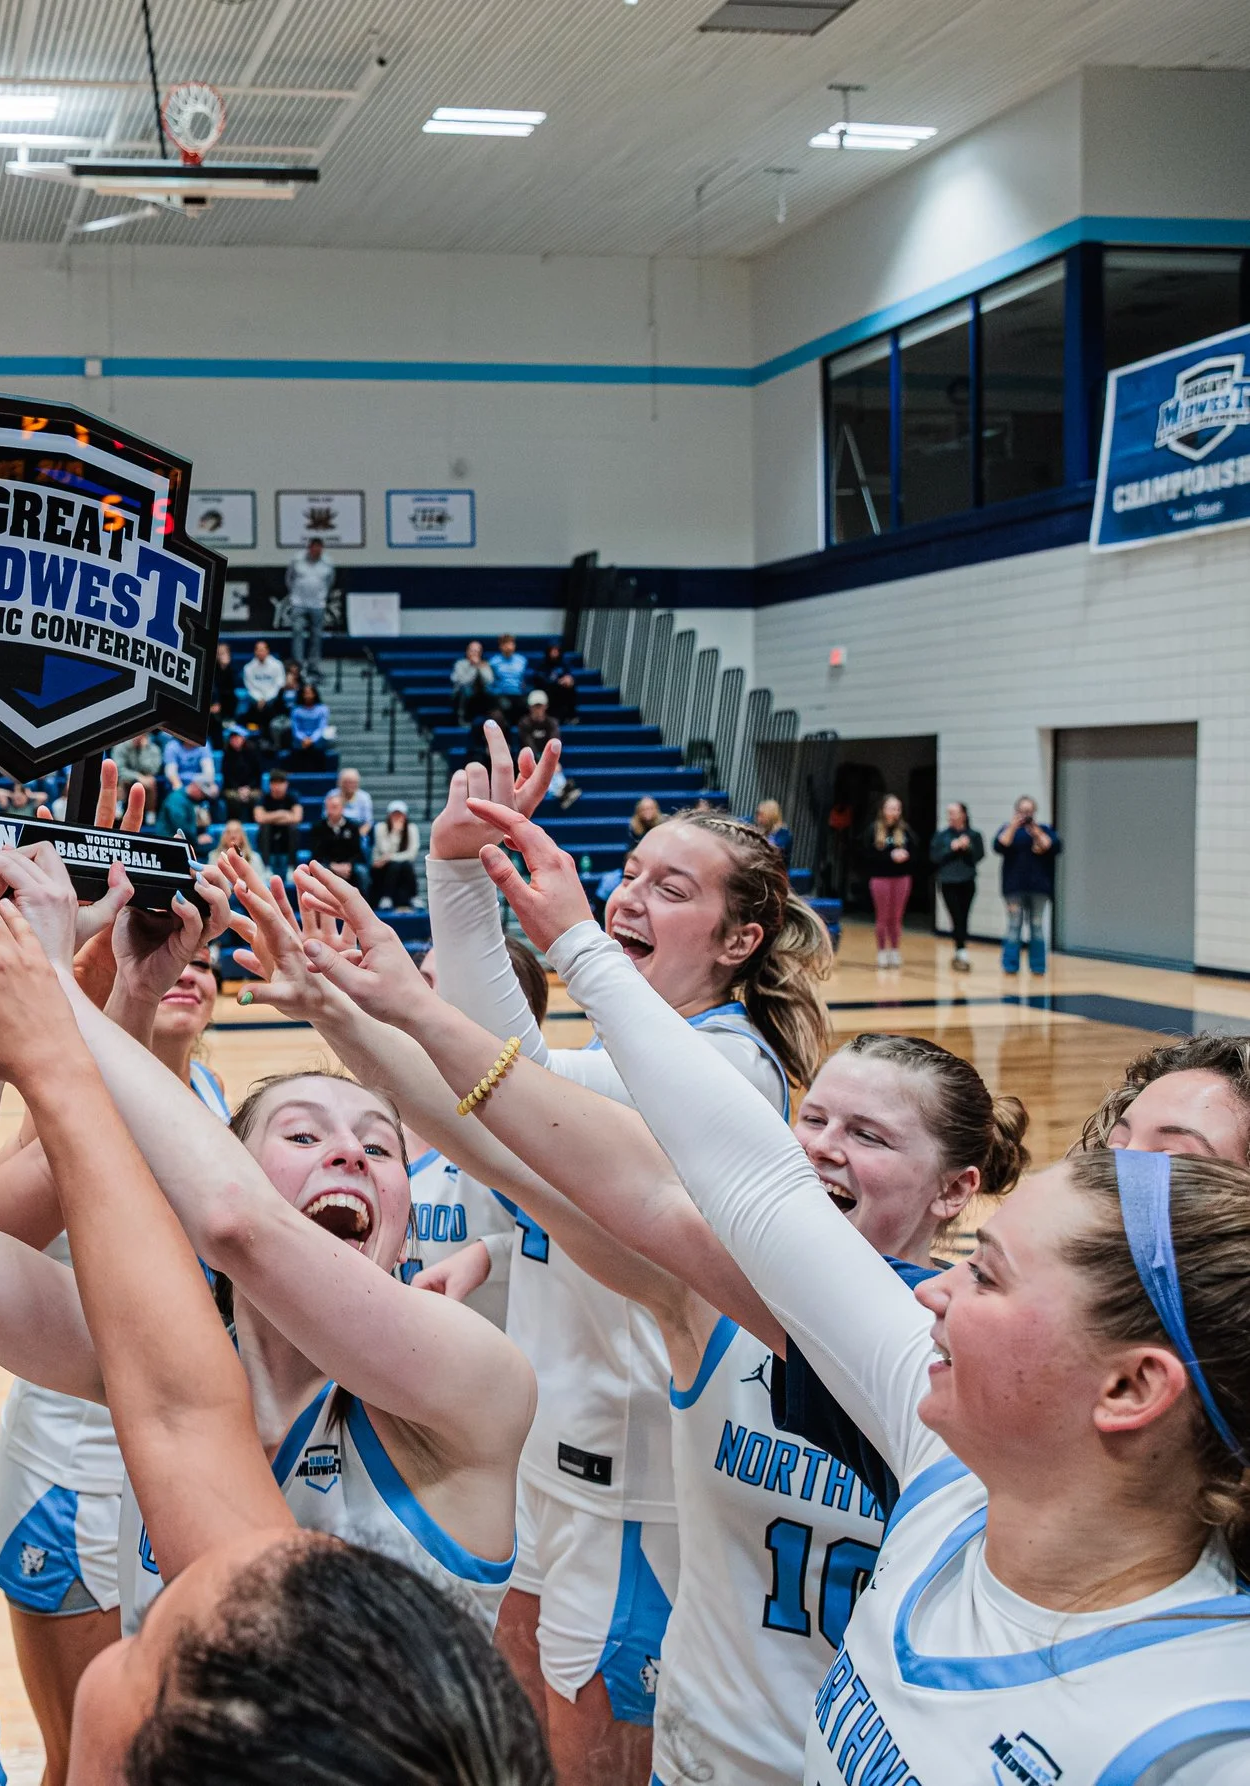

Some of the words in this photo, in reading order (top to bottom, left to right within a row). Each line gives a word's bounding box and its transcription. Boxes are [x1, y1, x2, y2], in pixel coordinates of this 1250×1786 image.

[31, 611, 193, 687] CONFERENCE
[54, 840, 162, 870] BASKETBALL
[85, 834, 131, 849] WOMEN'S
